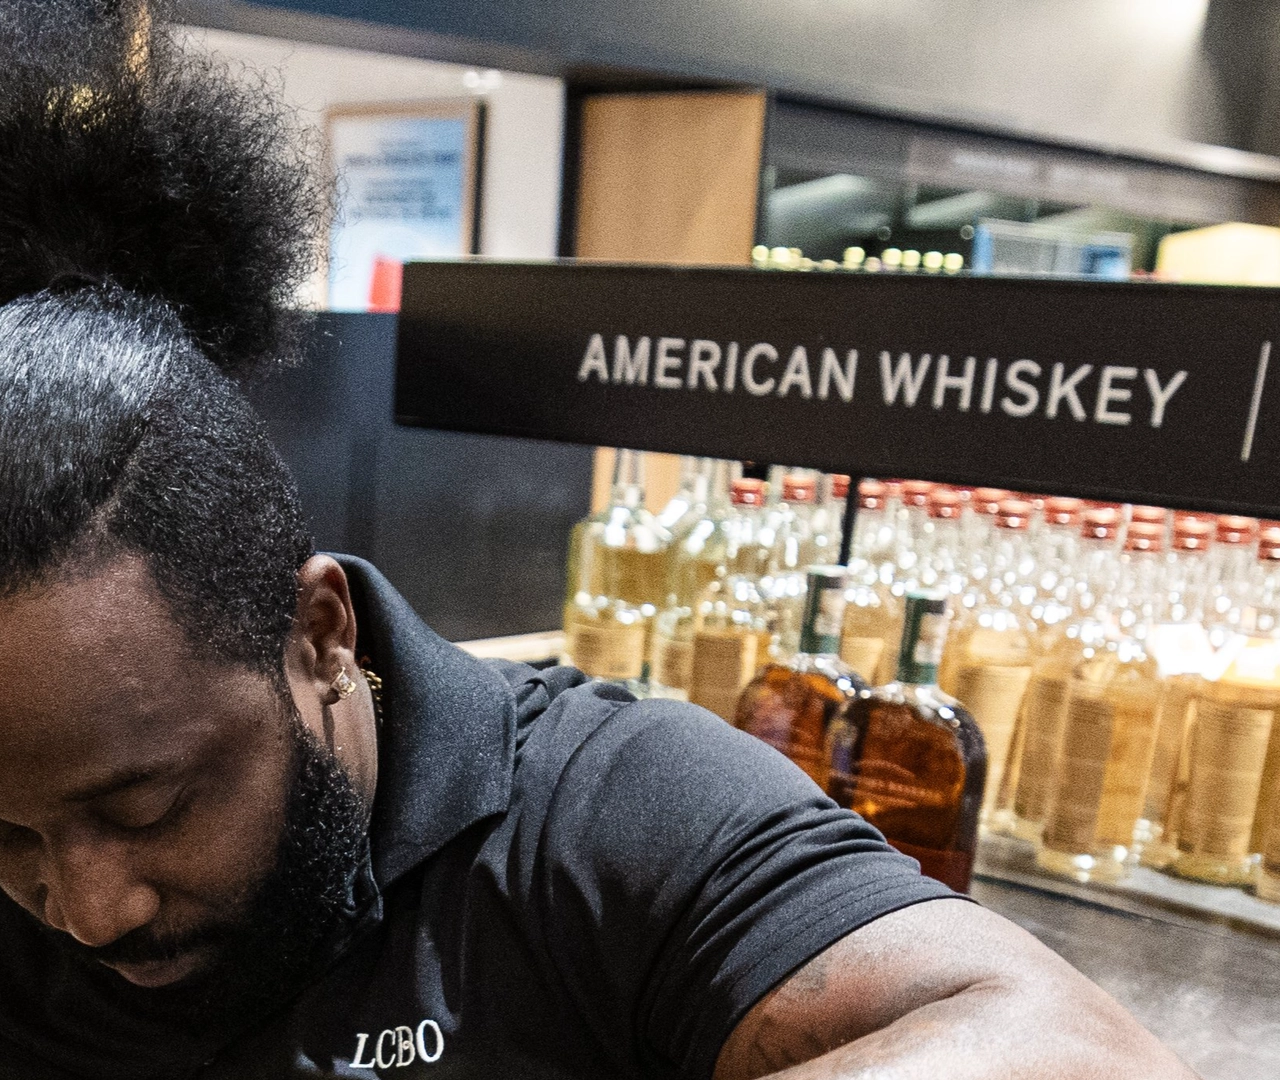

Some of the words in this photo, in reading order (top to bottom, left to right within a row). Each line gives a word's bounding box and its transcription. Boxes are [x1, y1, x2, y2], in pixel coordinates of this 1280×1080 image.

[579, 334, 859, 402] AMERICAN
[879, 350, 1188, 428] WHISKEY
[349, 1019, 444, 1069] LCBO
